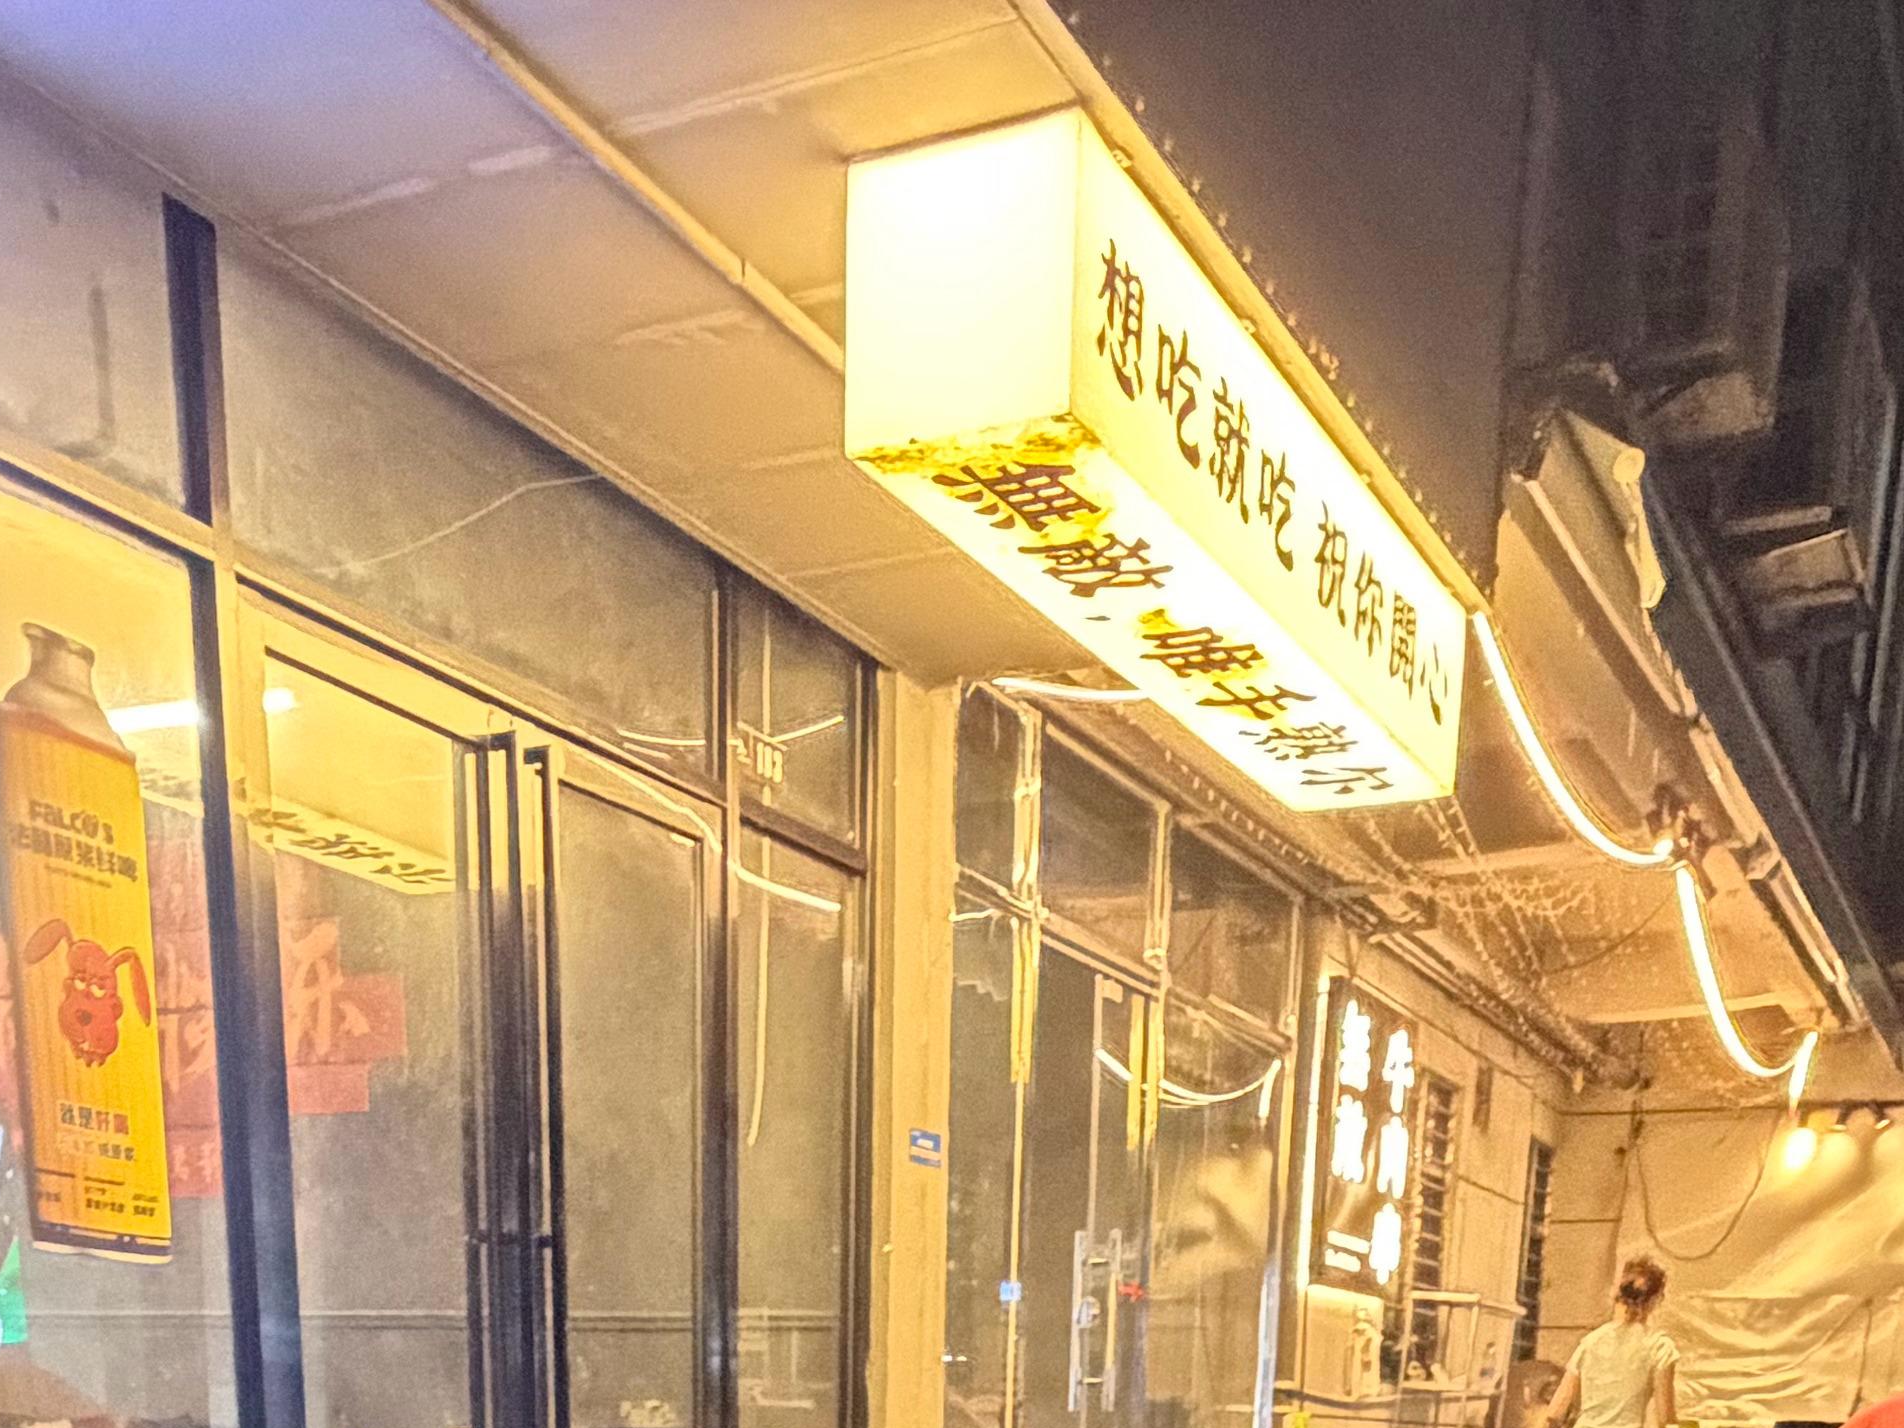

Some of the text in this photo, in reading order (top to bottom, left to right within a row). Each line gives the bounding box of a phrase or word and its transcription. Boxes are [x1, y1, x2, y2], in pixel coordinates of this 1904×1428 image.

[1096, 238, 1448, 725] 想吃就吃 祝你開心
